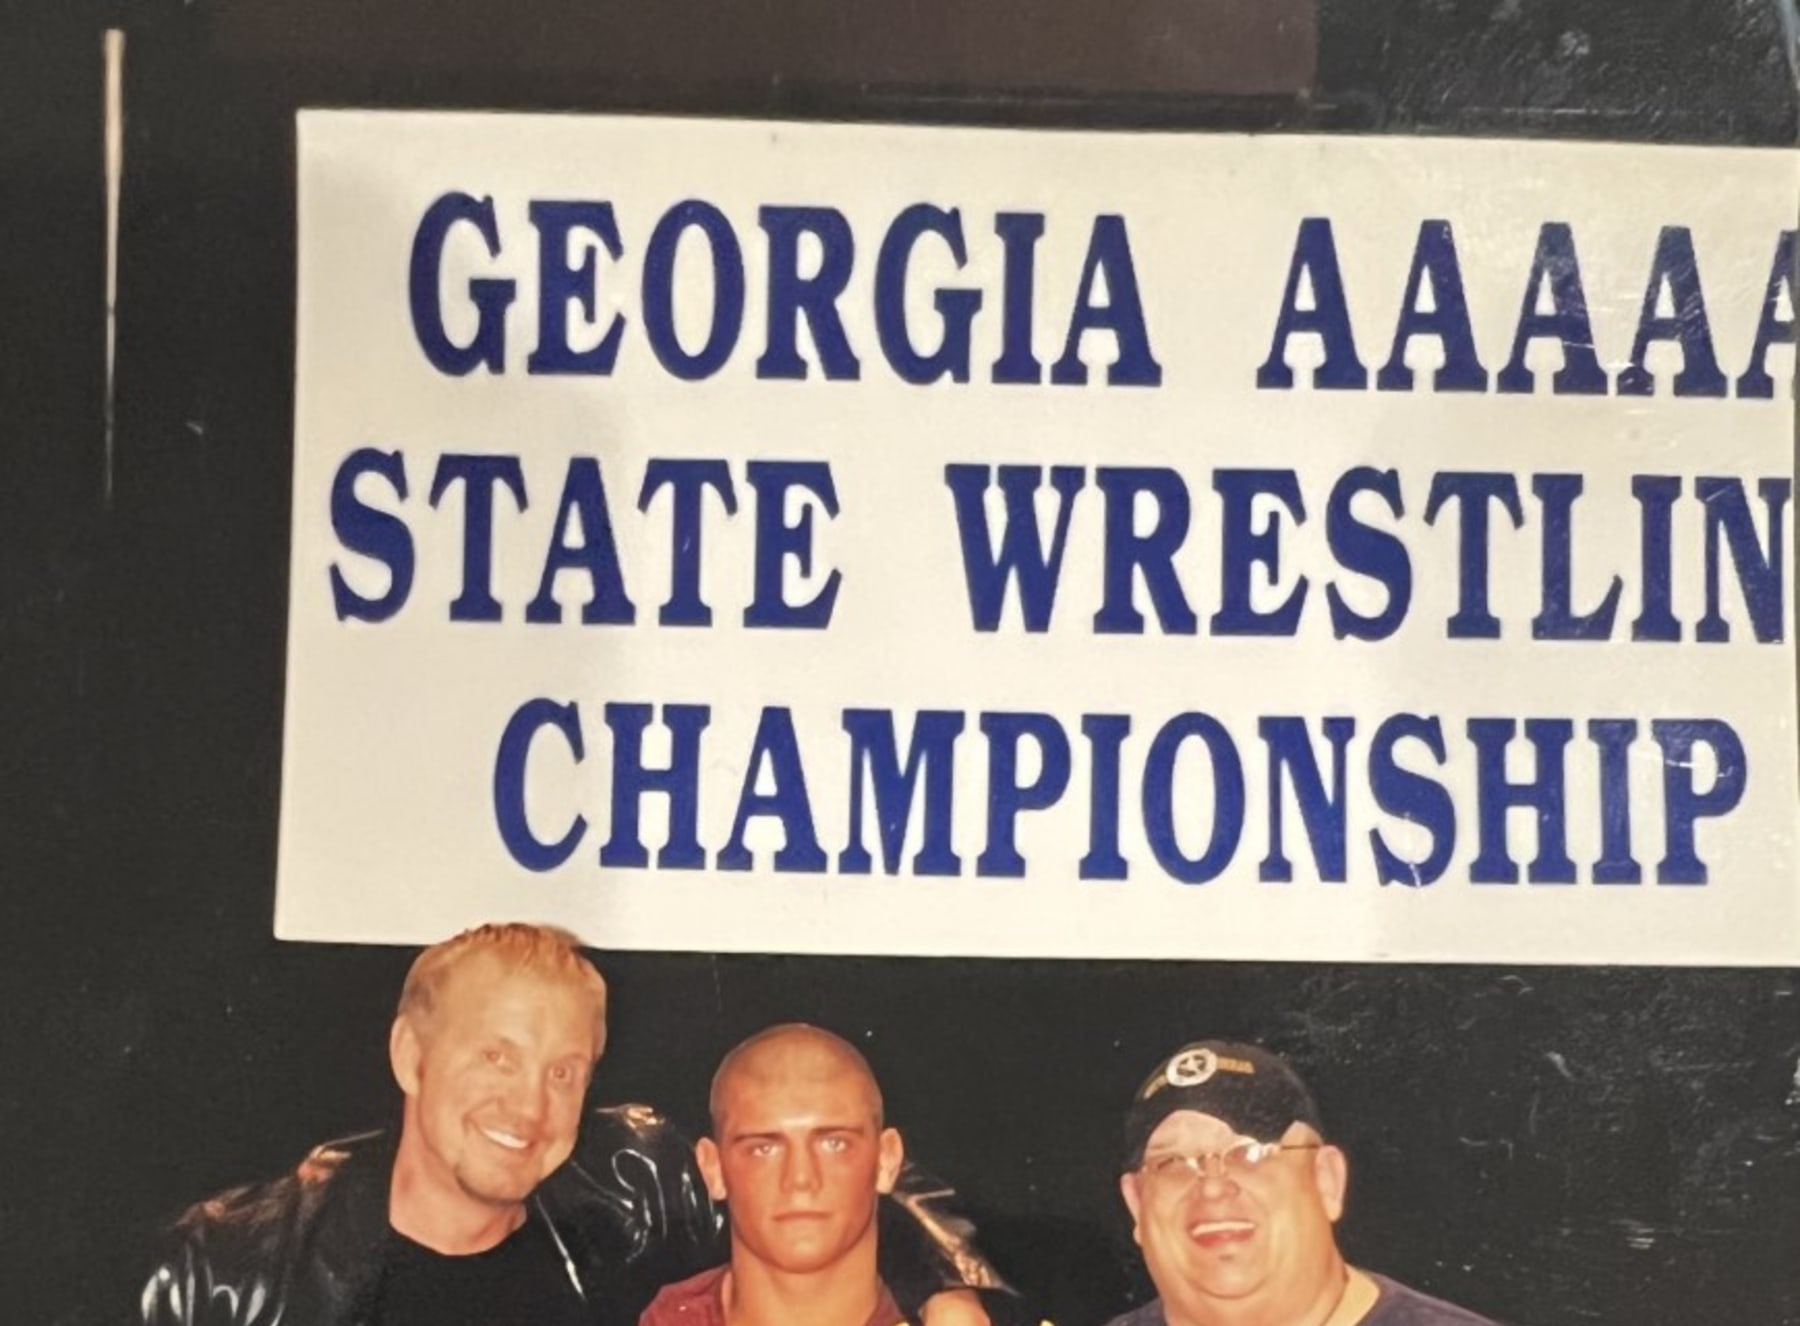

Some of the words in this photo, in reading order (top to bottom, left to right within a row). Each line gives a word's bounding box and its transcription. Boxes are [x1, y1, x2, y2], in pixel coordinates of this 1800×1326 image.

[410, 191, 1163, 387] GEORGIA
[329, 448, 839, 628] STATE
[945, 465, 1788, 644] WRESTLIN
[493, 698, 1748, 886] CHAMPIONSHIP
